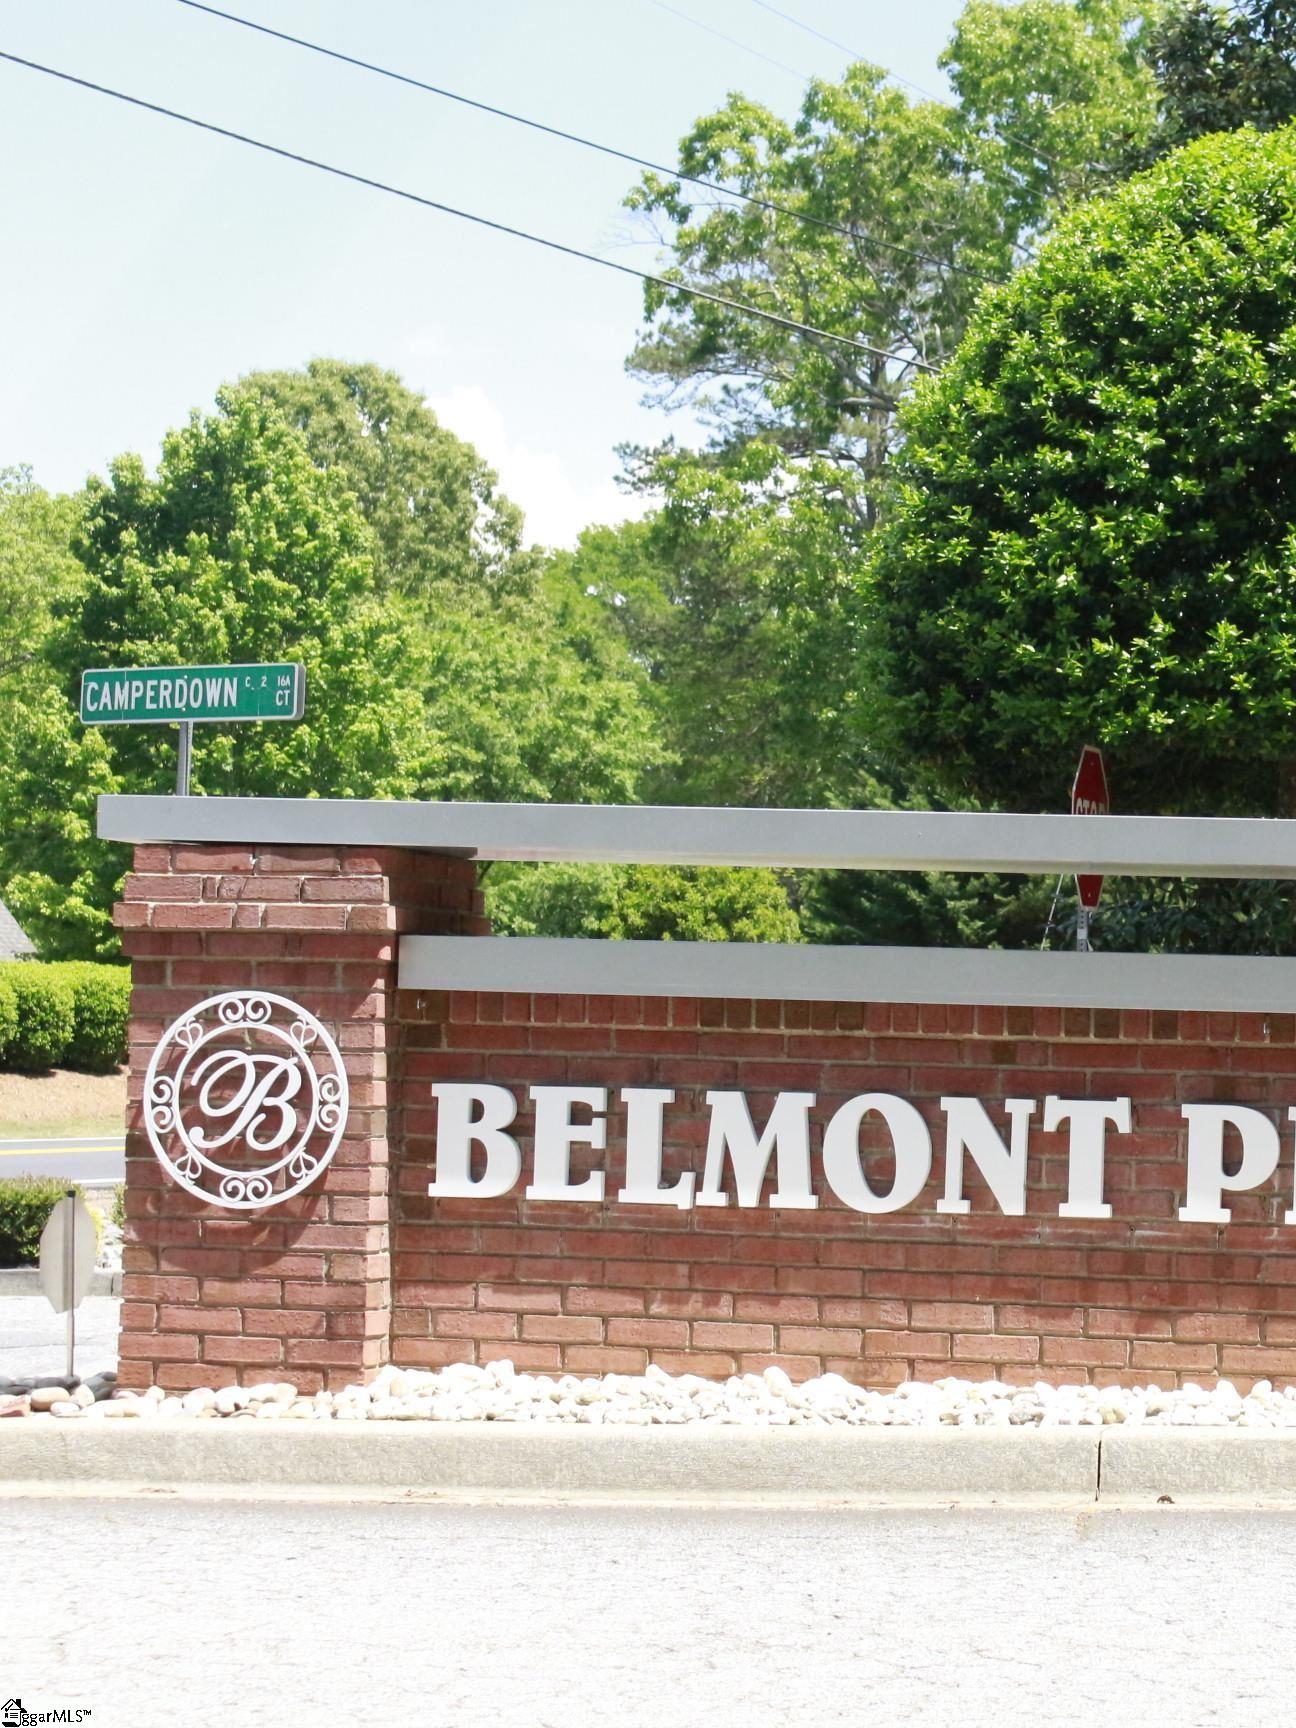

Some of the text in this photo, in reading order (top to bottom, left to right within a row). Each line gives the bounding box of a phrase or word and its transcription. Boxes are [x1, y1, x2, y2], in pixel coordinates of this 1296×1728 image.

[86, 677, 291, 712] CAMPERDOWN CT
[261, 675, 267, 688] 2
[277, 675, 291, 687] 16A
[428, 1082, 1132, 1218] BELMONT
